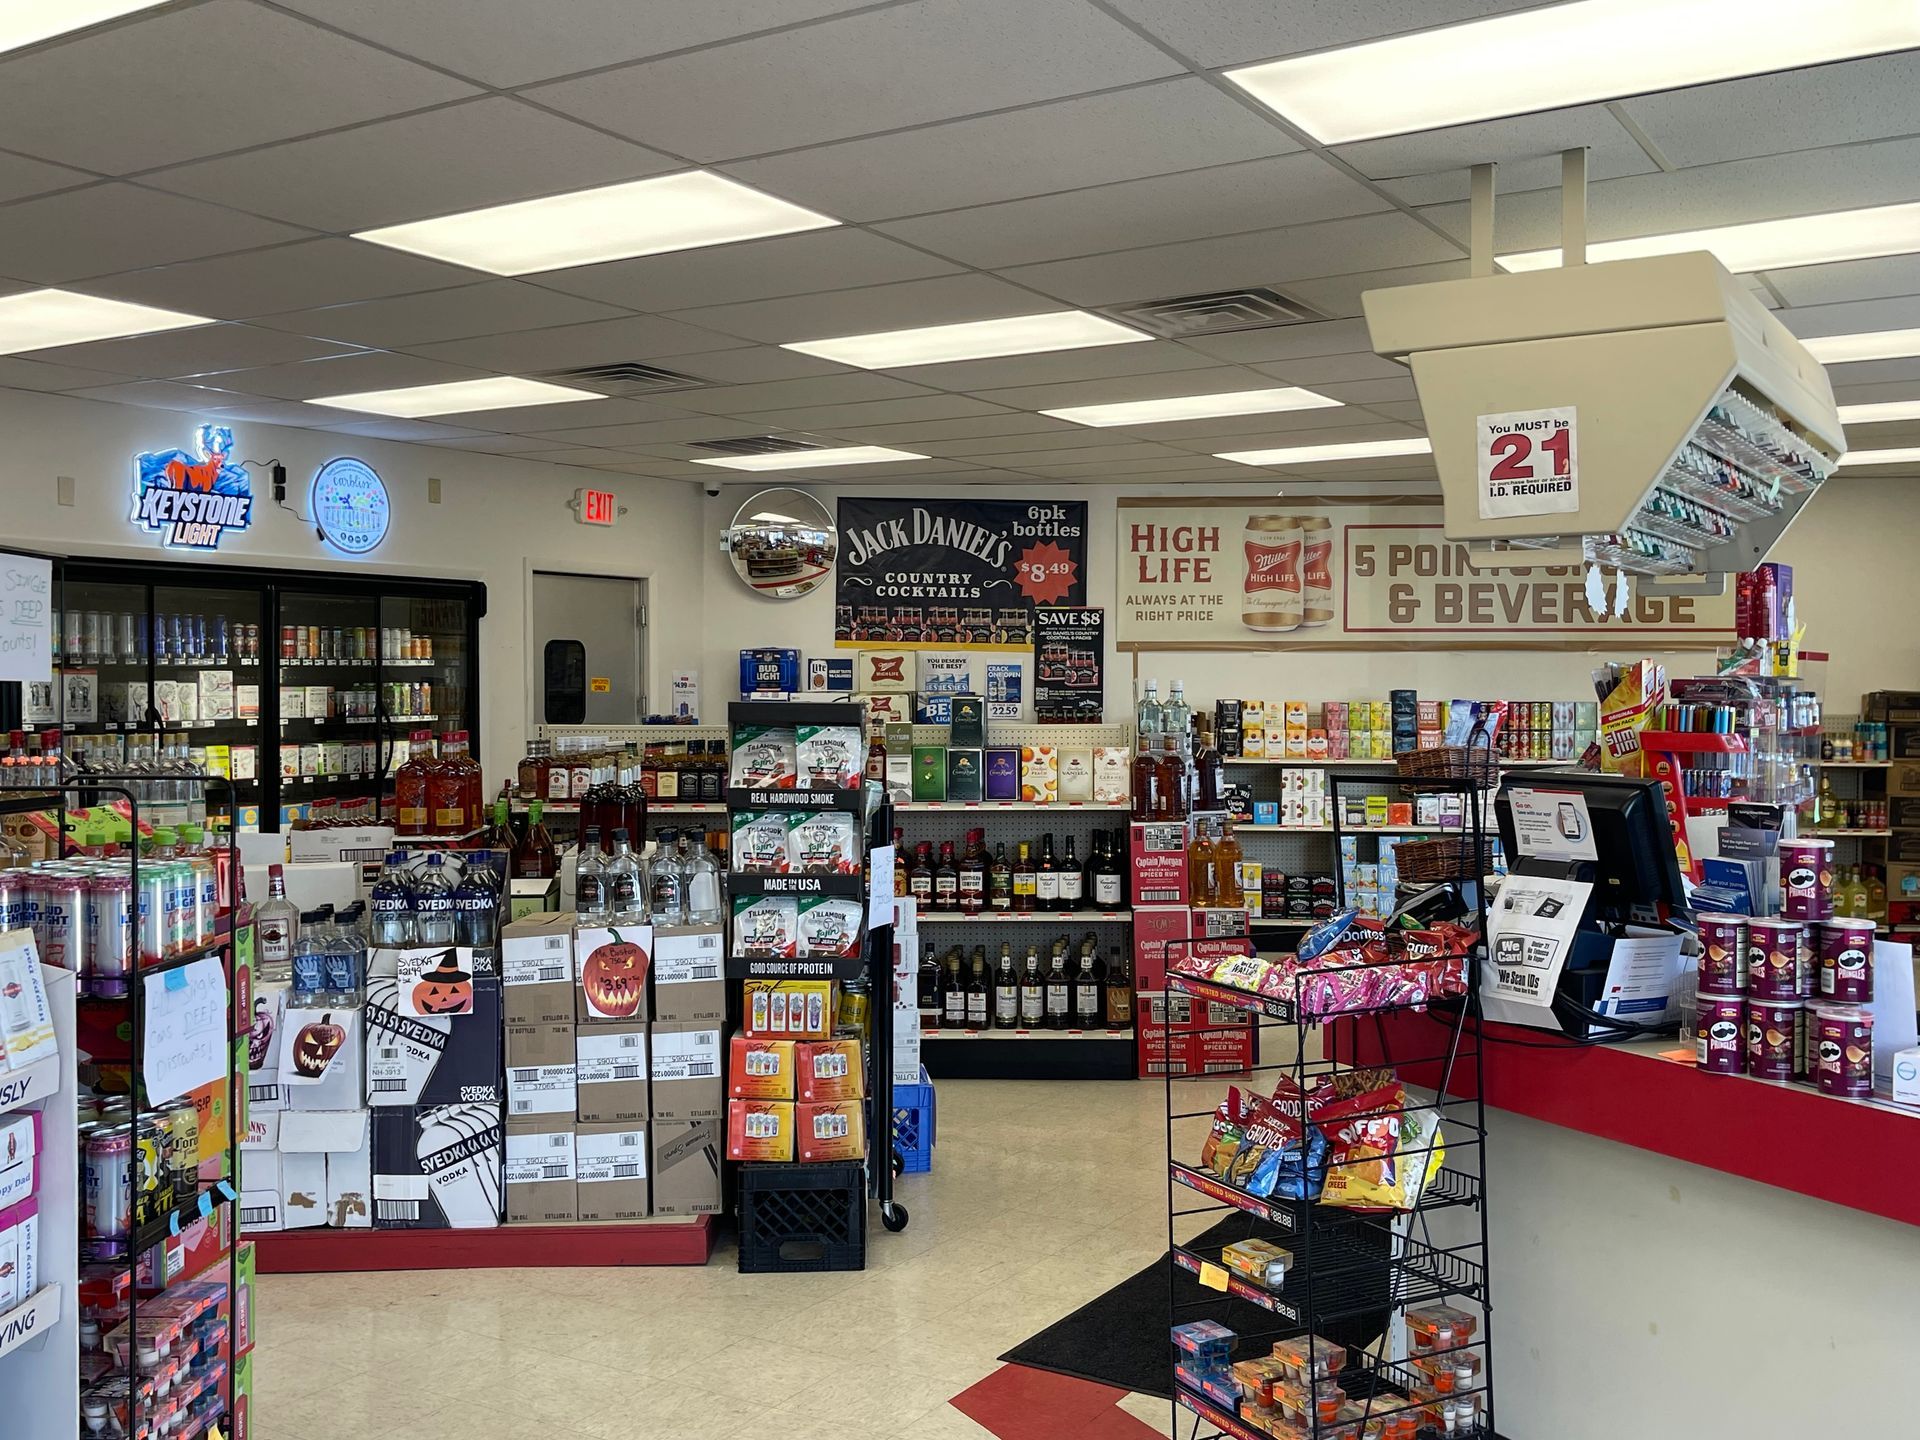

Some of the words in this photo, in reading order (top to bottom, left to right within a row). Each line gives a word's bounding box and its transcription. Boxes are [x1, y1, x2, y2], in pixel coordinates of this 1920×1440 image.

[1489, 425, 1510, 434] You
[1515, 420, 1550, 431] MUST
[1554, 419, 1569, 428] be
[1490, 429, 1570, 480] 21
[1490, 487, 1508, 497] I.D.
[1513, 481, 1571, 495] REQUIRED
[141, 488, 250, 526] KEYSTONE
[587, 491, 614, 523] EXIT
[1027, 505, 1066, 522] 6pk
[174, 522, 221, 546] LIGHT
[1012, 520, 1080, 537] bottles
[846, 517, 911, 566] JACK
[912, 507, 1013, 569] DANIEL'S
[1130, 524, 1220, 552] HIGH
[1254, 552, 1291, 569] Miller
[1355, 544, 1375, 577] 5
[1021, 562, 1069, 583] $8.49
[1138, 555, 1212, 583] LIFE
[1308, 571, 1326, 580] LIFE
[885, 572, 972, 585] COUNTRY
[1250, 573, 1273, 583] HIGH
[1275, 574, 1295, 583] LIFE
[876, 586, 981, 599] COCKTAILS
[1126, 595, 1176, 605] ALWAYS
[1180, 595, 1196, 605] AT
[1199, 595, 1223, 605] THE
[1389, 583, 1421, 623] &
[1435, 583, 1695, 624] BEVERAGE
[1038, 612, 1079, 625] SAVE
[1081, 611, 1100, 626] $8
[1136, 611, 1173, 621] RIGHT
[1177, 611, 1214, 621] PRICE
[758, 665, 778, 673] BUD
[756, 672, 780, 681] LIGHT
[1608, 709, 1633, 721] ORIGINAL
[1607, 722, 1620, 730] TWIN
[1621, 718, 1635, 726] PACK
[1605, 729, 1636, 744] slim
[1613, 739, 1638, 758] jim
[750, 793, 768, 804] REAL
[770, 793, 809, 804] HARDWOOD
[811, 793, 834, 804] SMOKE
[1135, 856, 1159, 868] Captain
[1158, 856, 1184, 867] Morgan
[764, 879, 787, 890] MADE
[799, 879, 821, 890] USA
[1789, 886, 1816, 899] PRINGLES
[371, 899, 408, 910] SVEDKA
[456, 899, 494, 910] SVEDKA
[1341, 929, 1385, 943] Doritos
[610, 947, 637, 957] Boston
[1197, 942, 1220, 953] Captain
[1220, 942, 1245, 953] Morgan
[1502, 941, 1520, 952] We
[1497, 951, 1522, 962] Card
[750, 963, 765, 974] GOOD
[766, 963, 789, 974] SOURCE
[790, 963, 797, 974] OF
[798, 963, 833, 974] PROTEIN
[1838, 967, 1865, 980] PRINGLES
[1498, 969, 1510, 984] We
[1511, 971, 1526, 987] Scan
[1527, 973, 1540, 989] IDs
[1196, 986, 1218, 997] TWISTED
[1220, 991, 1238, 1002] SHOTZ
[399, 1020, 445, 1049] SVEDKA
[1710, 1039, 1737, 1051] PRINGLES
[461, 1086, 496, 1094] SVEDKA
[461, 1093, 495, 1101] VODKA
[420, 1144, 469, 1174] SVEDKA
[15, 1172, 31, 1188] Dad
[436, 1167, 468, 1185] VODKA
[1200, 1180, 1224, 1196] TWISTED
[1224, 1189, 1243, 1204] SHOTZ
[1327, 1181, 1347, 1189] CHEESE
[1206, 1410, 1230, 1430] TWISTED
